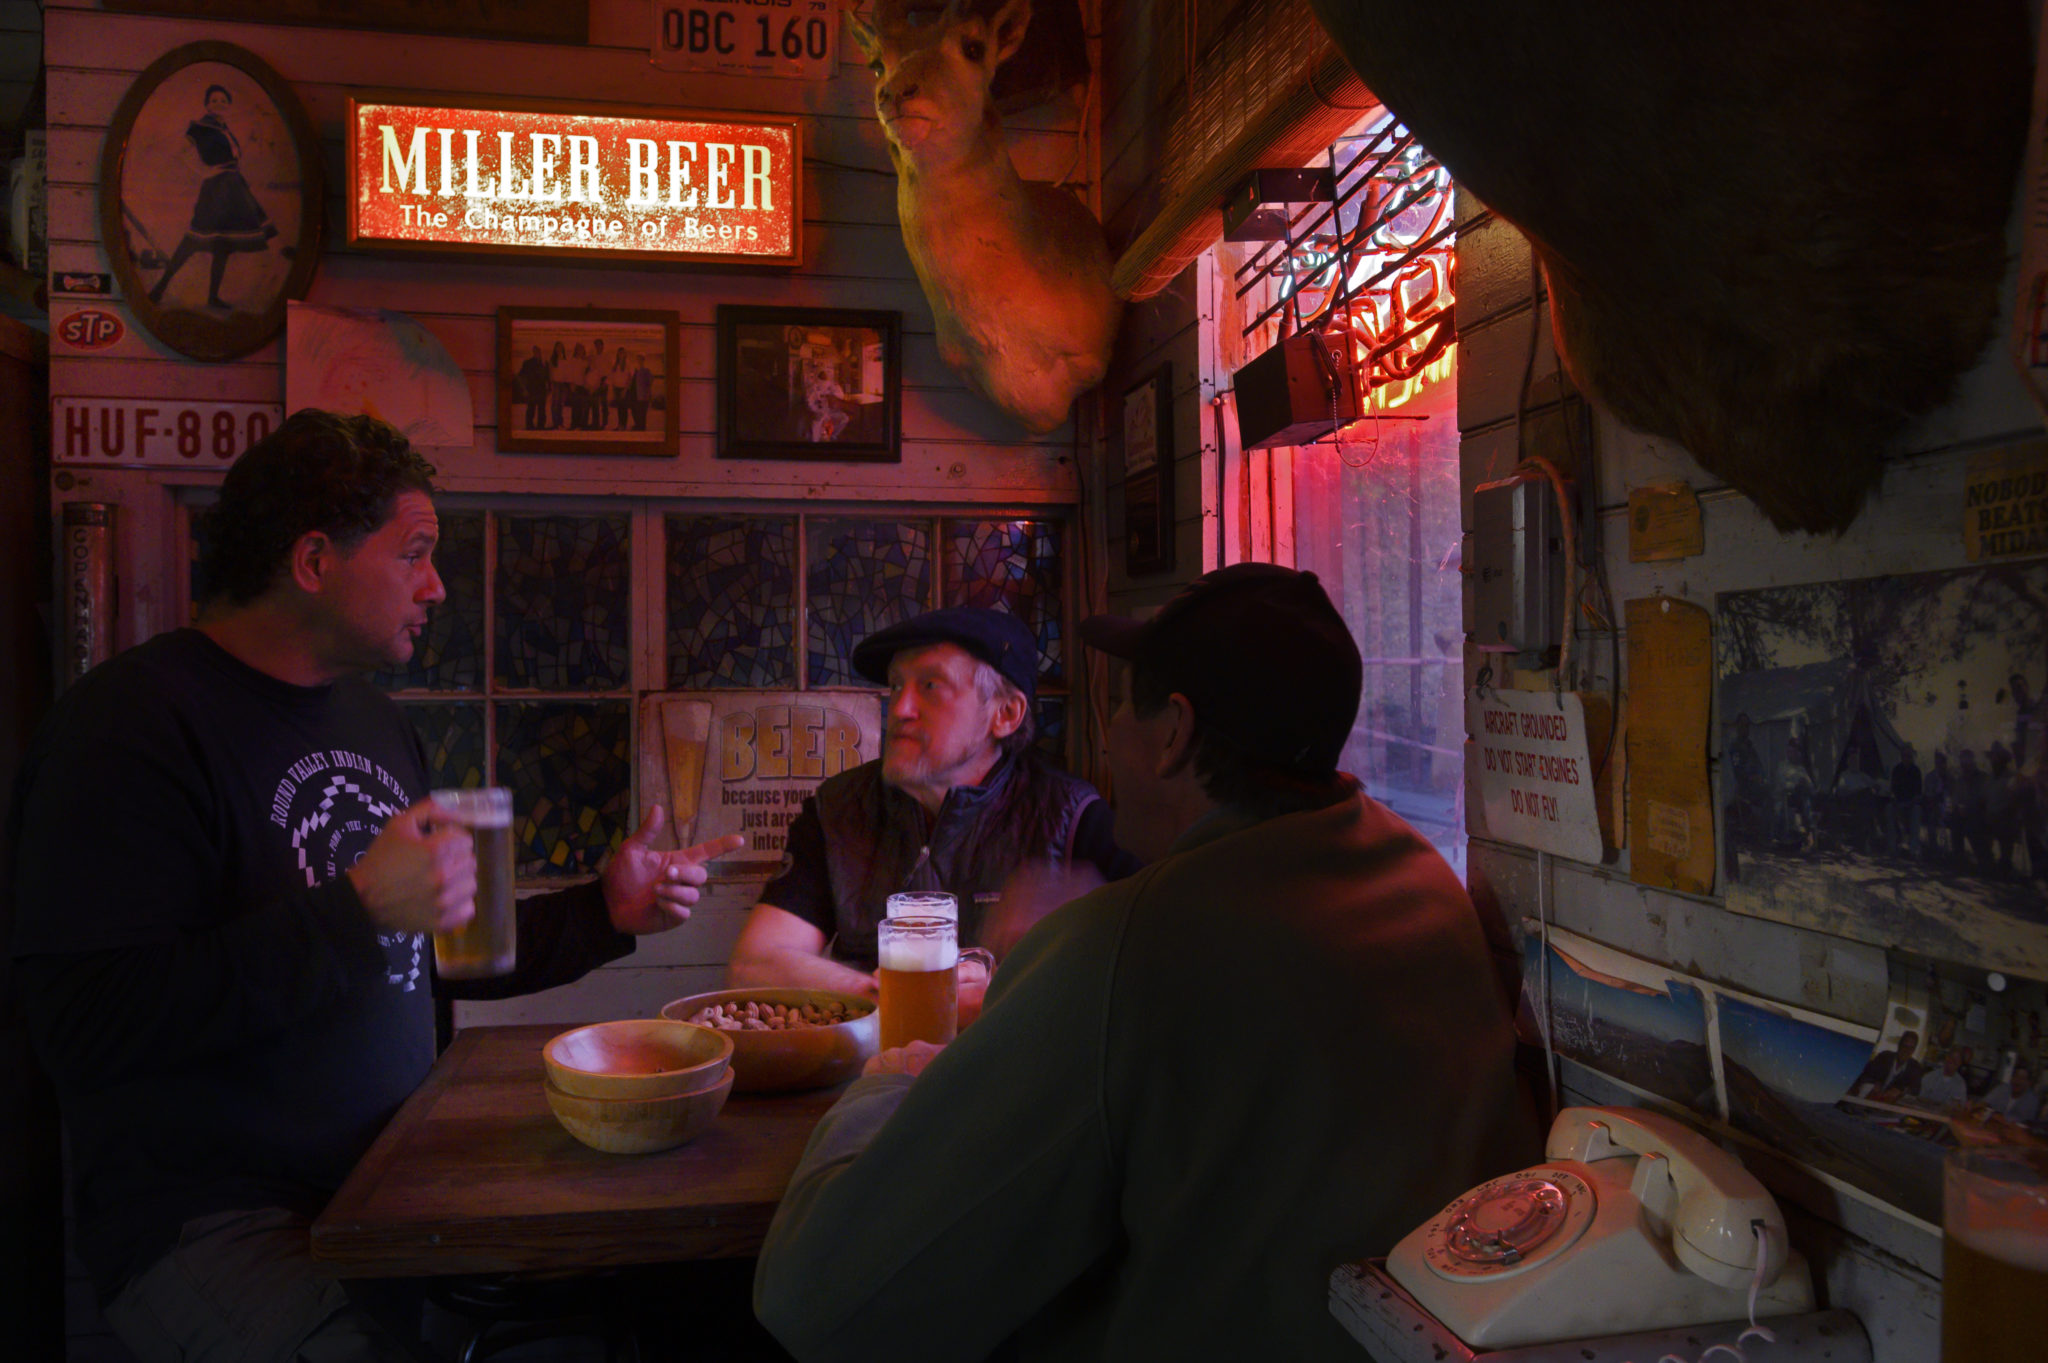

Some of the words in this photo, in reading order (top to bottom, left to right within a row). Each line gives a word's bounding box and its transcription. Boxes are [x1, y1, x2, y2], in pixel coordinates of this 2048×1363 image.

[754, 15, 828, 60] 160
[378, 124, 603, 204] MILLER
[626, 137, 775, 211] BEER
[399, 204, 449, 229] The
[464, 206, 624, 242] Champagne
[642, 215, 668, 240] of
[684, 217, 759, 241] Beers
[66, 312, 116, 346] STP
[1977, 497, 2048, 531] BEATS
[720, 704, 863, 783] BEER
[1483, 710, 1519, 736] AIRCRAFT
[1520, 711, 1567, 741] GROUNDED
[1484, 747, 1497, 772] DO
[1514, 751, 1536, 777] START
[1538, 754, 1579, 785] ENGINES
[270, 778, 297, 830] ROUND
[287, 751, 330, 784] VALLEY
[329, 749, 373, 776] INDIAN
[722, 787, 782, 805] because
[1511, 788, 1524, 814] DO
[1524, 791, 1540, 818] NOT
[740, 808, 768, 831] just
[770, 812, 801, 827] are
